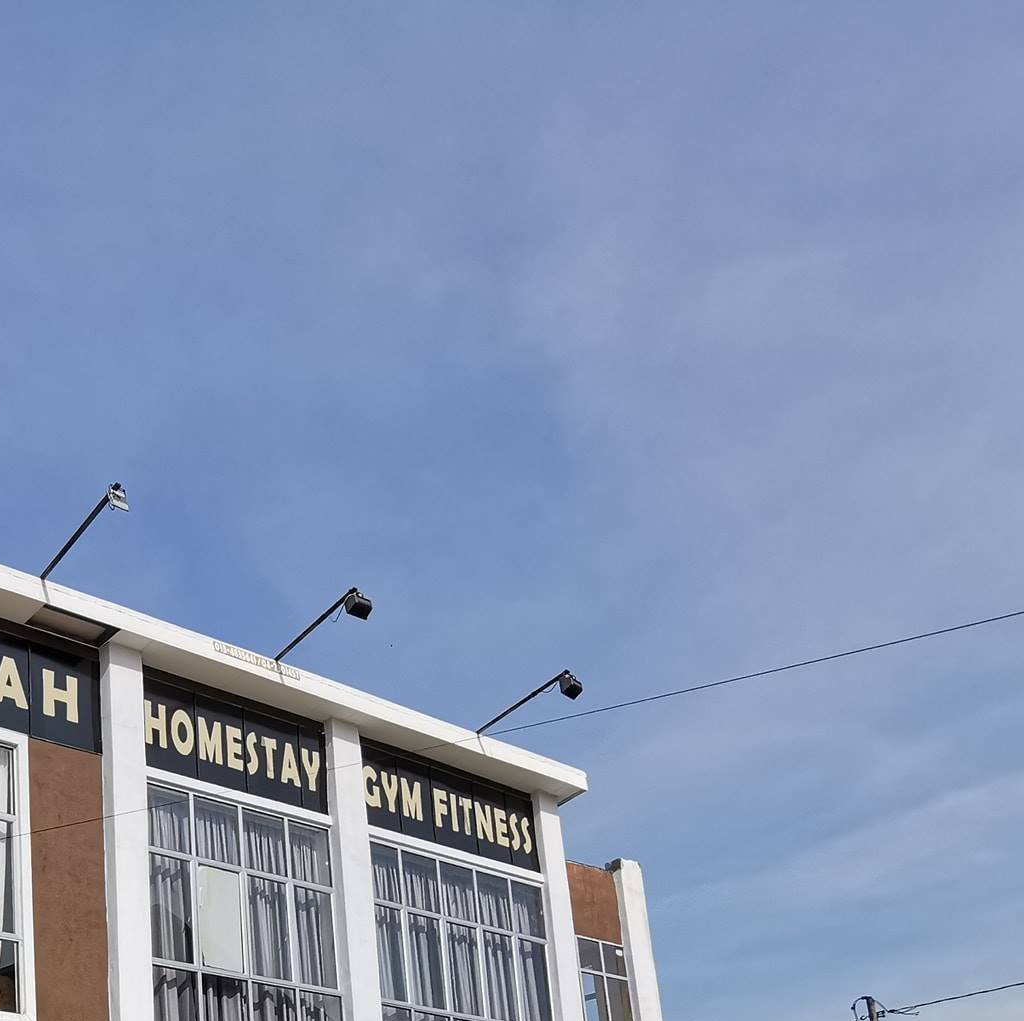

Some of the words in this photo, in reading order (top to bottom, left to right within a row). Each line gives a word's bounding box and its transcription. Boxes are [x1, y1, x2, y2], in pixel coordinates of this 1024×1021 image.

[144, 700, 321, 791] HOMESTAY
[363, 766, 424, 821] GYM
[433, 787, 533, 854] FITNESS
